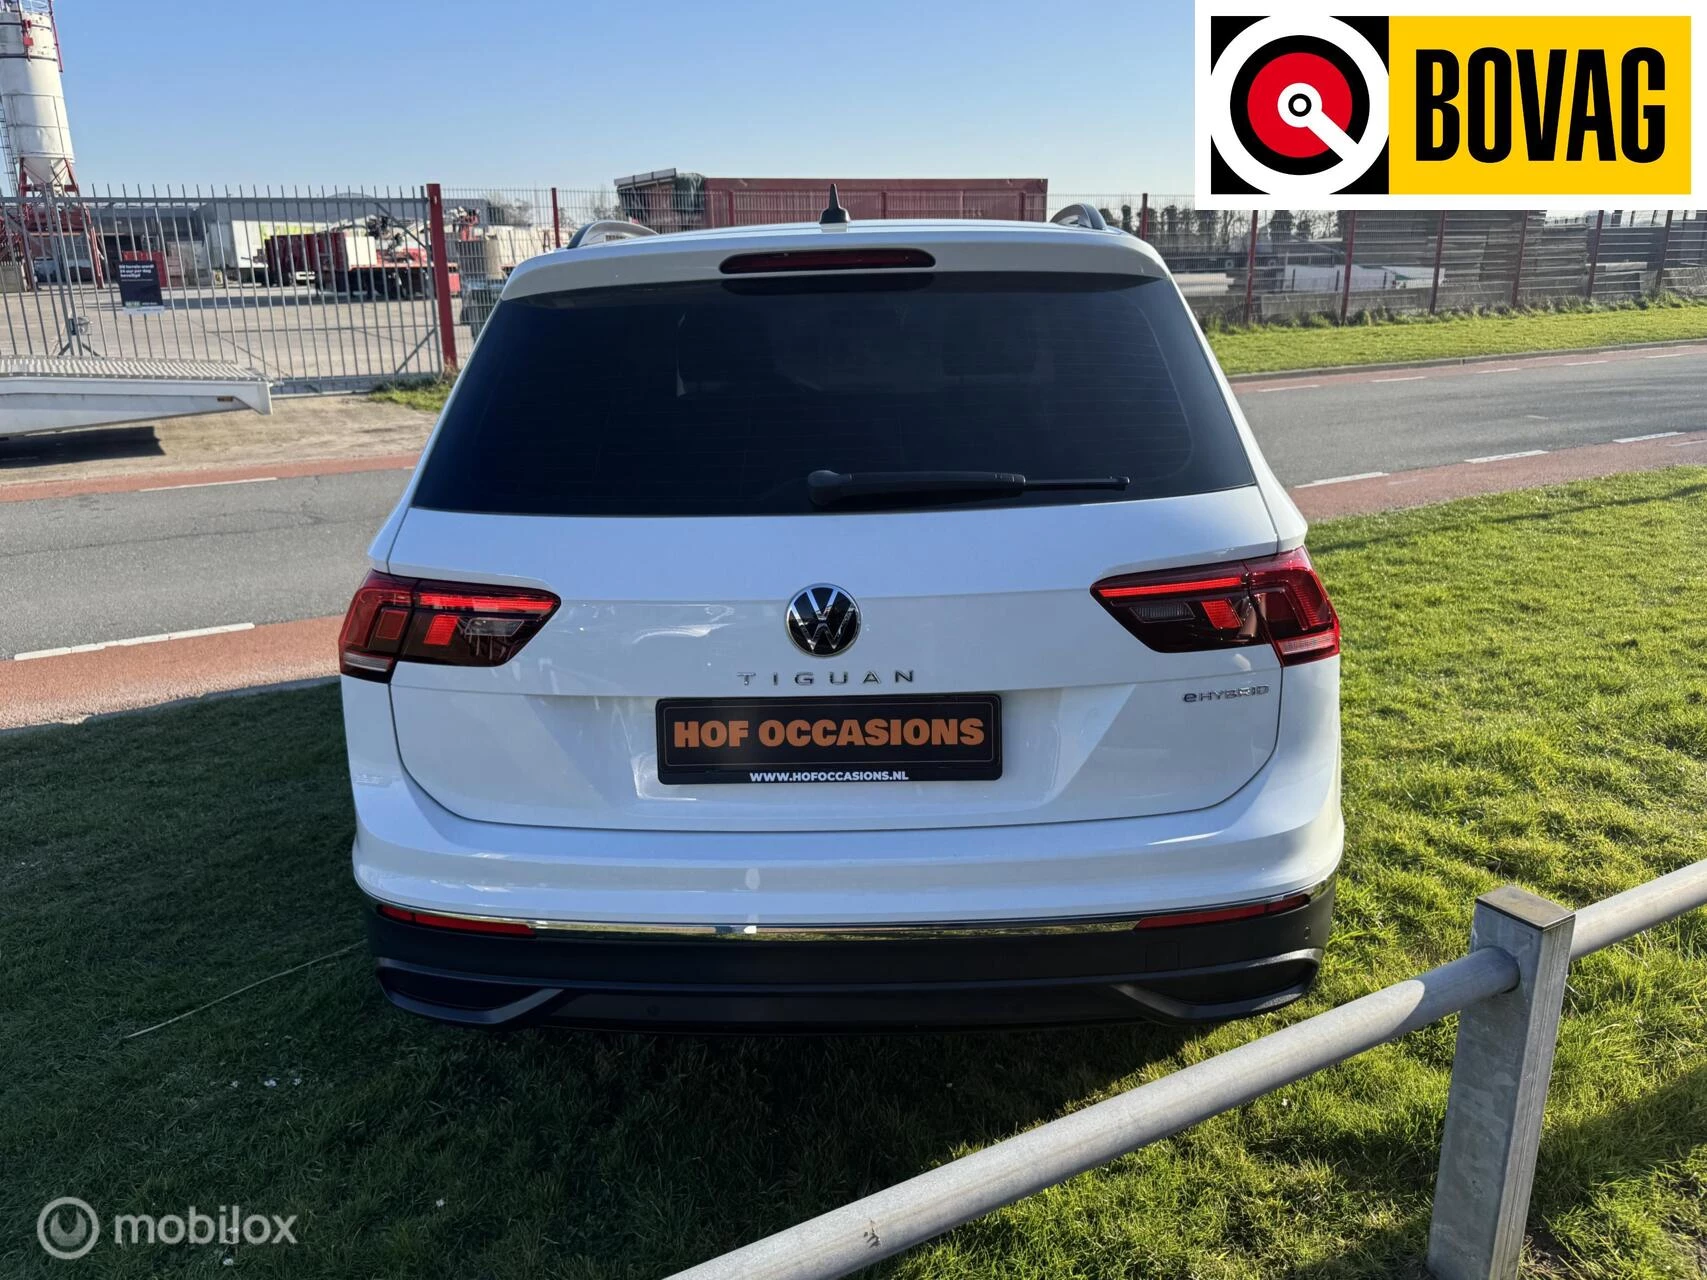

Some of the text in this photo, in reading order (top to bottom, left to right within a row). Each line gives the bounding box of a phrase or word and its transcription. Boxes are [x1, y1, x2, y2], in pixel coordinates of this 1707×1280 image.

[737, 669, 916, 686] TIGUAN
[673, 717, 985, 748] HOF OCCASIONS
[750, 770, 910, 783] WWW.HOFOCCASIONS.NL
